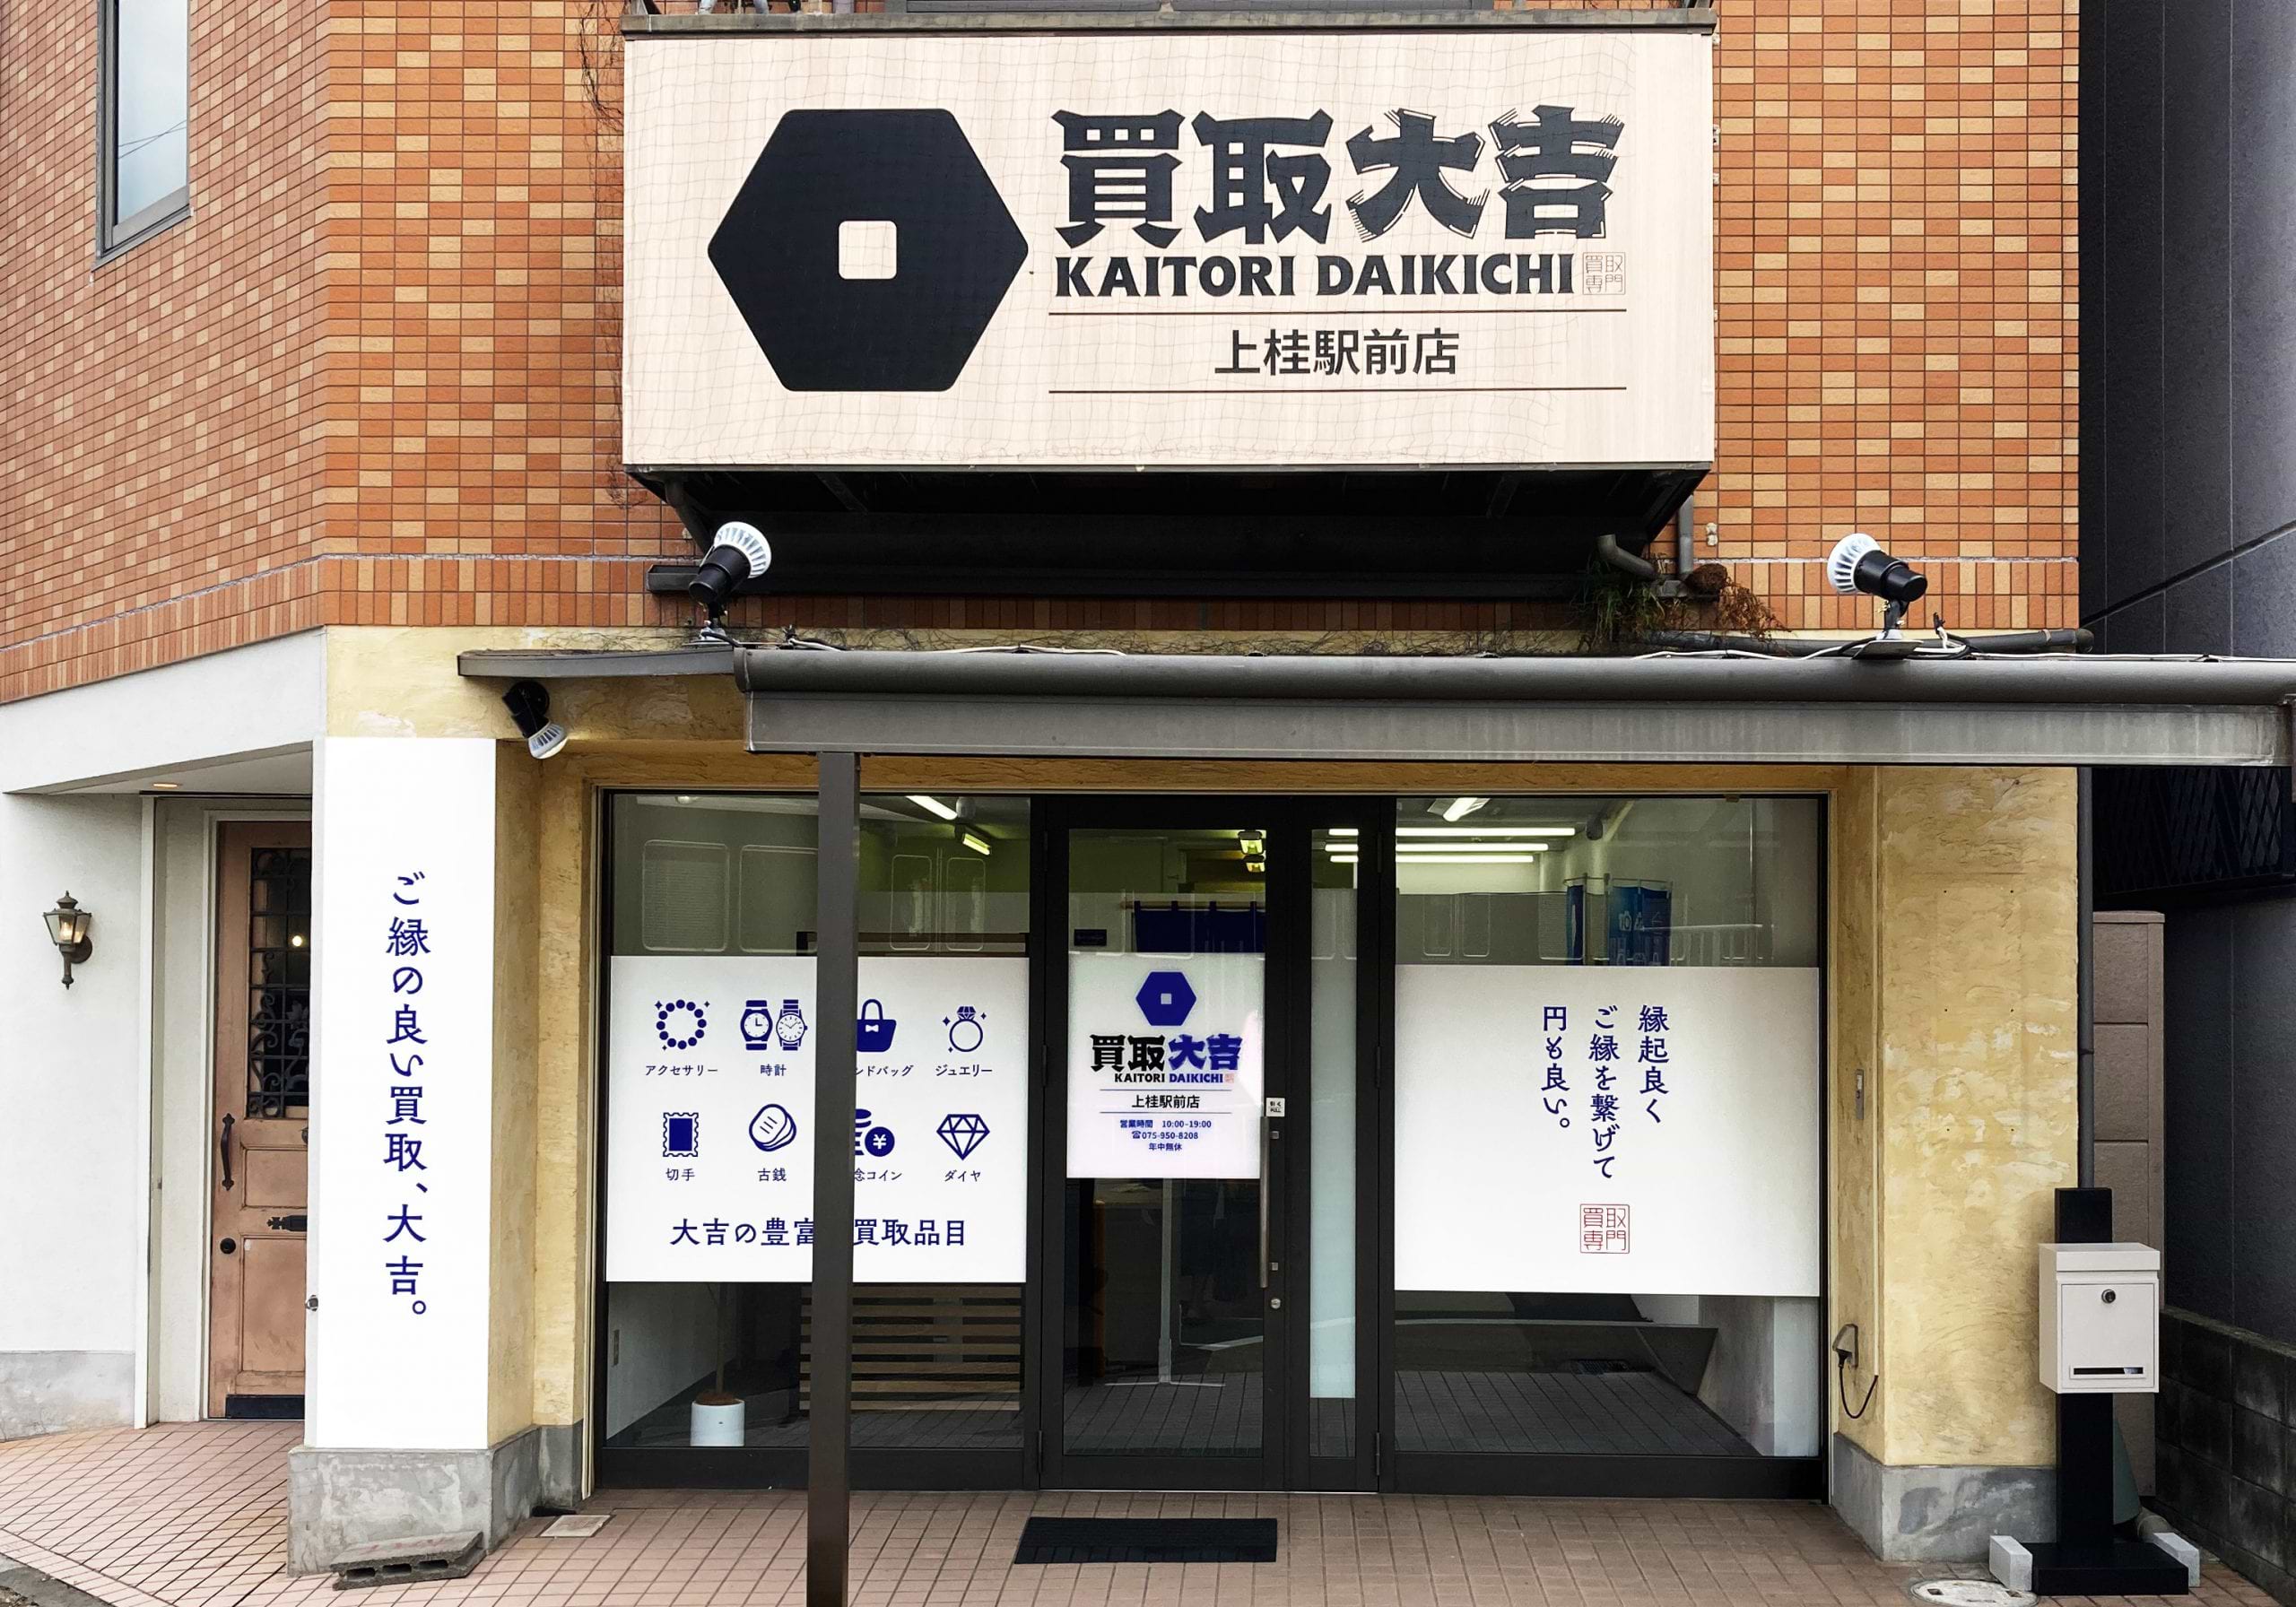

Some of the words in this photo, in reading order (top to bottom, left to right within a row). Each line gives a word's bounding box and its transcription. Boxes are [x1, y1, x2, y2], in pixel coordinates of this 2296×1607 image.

[1051, 105, 1624, 248] 買取大吉
[1056, 256, 1295, 297] KAITORI
[1317, 253, 1574, 295] DAIKICHI
[1214, 327, 1459, 376] 上桂駅前店
[1090, 1034, 1243, 1072] 買取大吉
[645, 1064, 718, 1077] アクセサリー
[760, 1064, 787, 1077] 時計
[855, 1064, 914, 1077] ンドバッグ
[935, 1064, 992, 1077] ジュエリー
[1541, 1005, 1570, 1128] 円も良い。
[1638, 1004, 1670, 1124] 縁起良く
[1115, 1073, 1165, 1083] KAITORI
[1170, 1073, 1223, 1083] DAIKICHI
[384, 872, 430, 1316] ご縁の良い買取、大吉。
[1588, 1004, 1620, 1178] ご縁を繋げて
[1131, 1094, 1200, 1108] 上桂駅前店
[1120, 1119, 1153, 1129] 営業時間
[1148, 1142, 1183, 1151] 年中無休
[665, 1168, 695, 1182] 切手
[757, 1168, 787, 1182] 古銭
[854, 1168, 902, 1182] 念コイン
[944, 1169, 981, 1183] ダイヤ
[669, 1218, 965, 1246] 大吉の豊富買取品目
